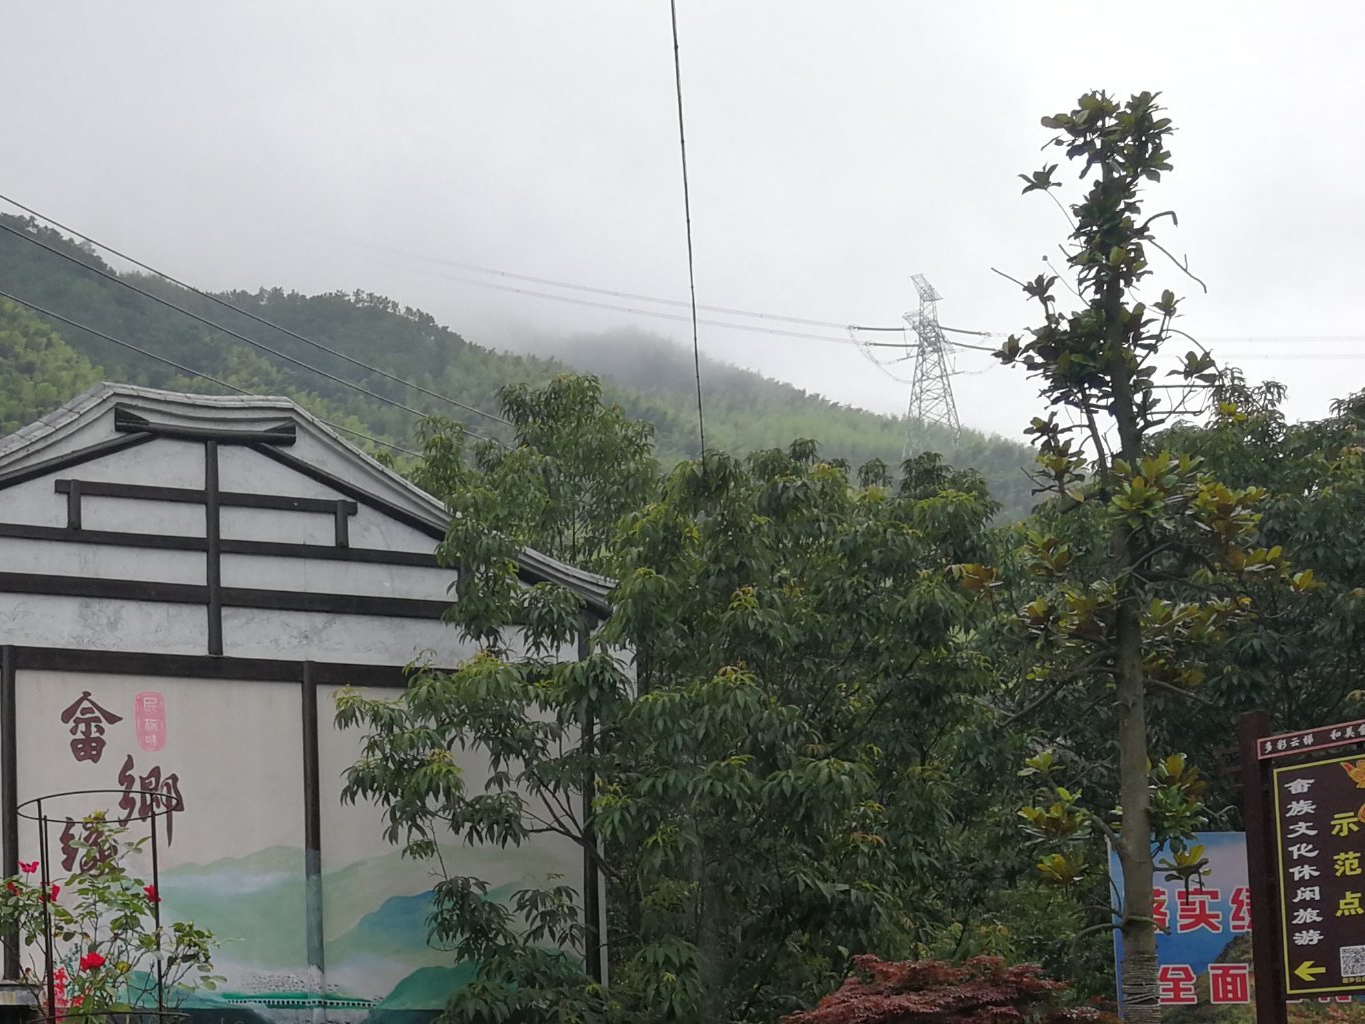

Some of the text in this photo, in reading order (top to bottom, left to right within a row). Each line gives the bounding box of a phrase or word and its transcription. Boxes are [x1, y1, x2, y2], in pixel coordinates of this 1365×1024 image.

[1284, 778, 1325, 946] 畲族文化休闲旅游
[1330, 811, 1365, 917] 示范点
[1158, 963, 1251, 1005] 全面
